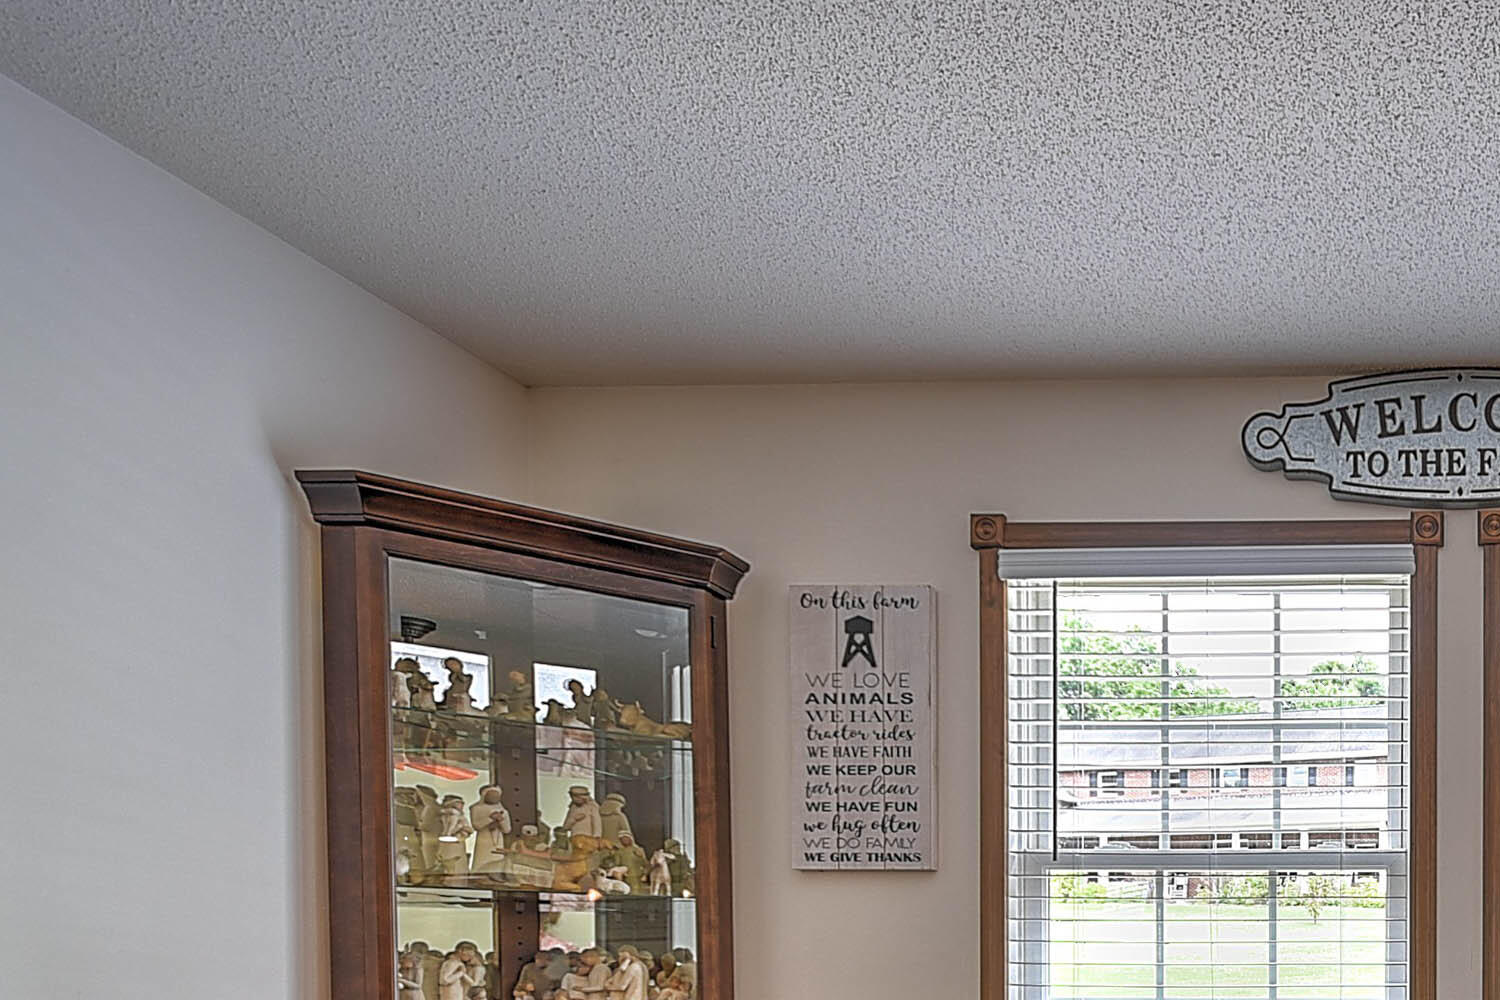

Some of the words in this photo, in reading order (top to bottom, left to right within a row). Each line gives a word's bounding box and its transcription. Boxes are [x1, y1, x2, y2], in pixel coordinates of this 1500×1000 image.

[1346, 450, 1390, 478] TO
[1399, 449, 1467, 477] THE
[800, 592, 827, 609] On
[832, 590, 866, 610] this
[873, 591, 919, 610] farm
[805, 672, 843, 689] WE
[853, 672, 910, 689] LOVE
[805, 692, 914, 705] ANIMALS
[805, 710, 844, 723] WE
[850, 710, 914, 723] HAVE
[807, 724, 869, 741] tractor
[873, 724, 916, 741] rides
[807, 746, 829, 758] WE
[833, 746, 869, 758] HAVE
[873, 746, 912, 758] FAITH
[806, 765, 832, 776] WE
[836, 765, 877, 776] KEEP
[881, 765, 916, 776] OUR
[805, 781, 857, 799] farm
[859, 775, 919, 797] clean
[805, 802, 832, 812] WE
[836, 802, 880, 812] HAVE
[884, 802, 918, 812] FUN
[804, 821, 827, 832] we
[832, 814, 867, 837] hug
[871, 814, 921, 833] often
[803, 837, 832, 849] WE
[836, 837, 861, 849] DO
[804, 852, 827, 862] WE
[830, 852, 862, 863] GIVE
[866, 852, 922, 863] THANKS
